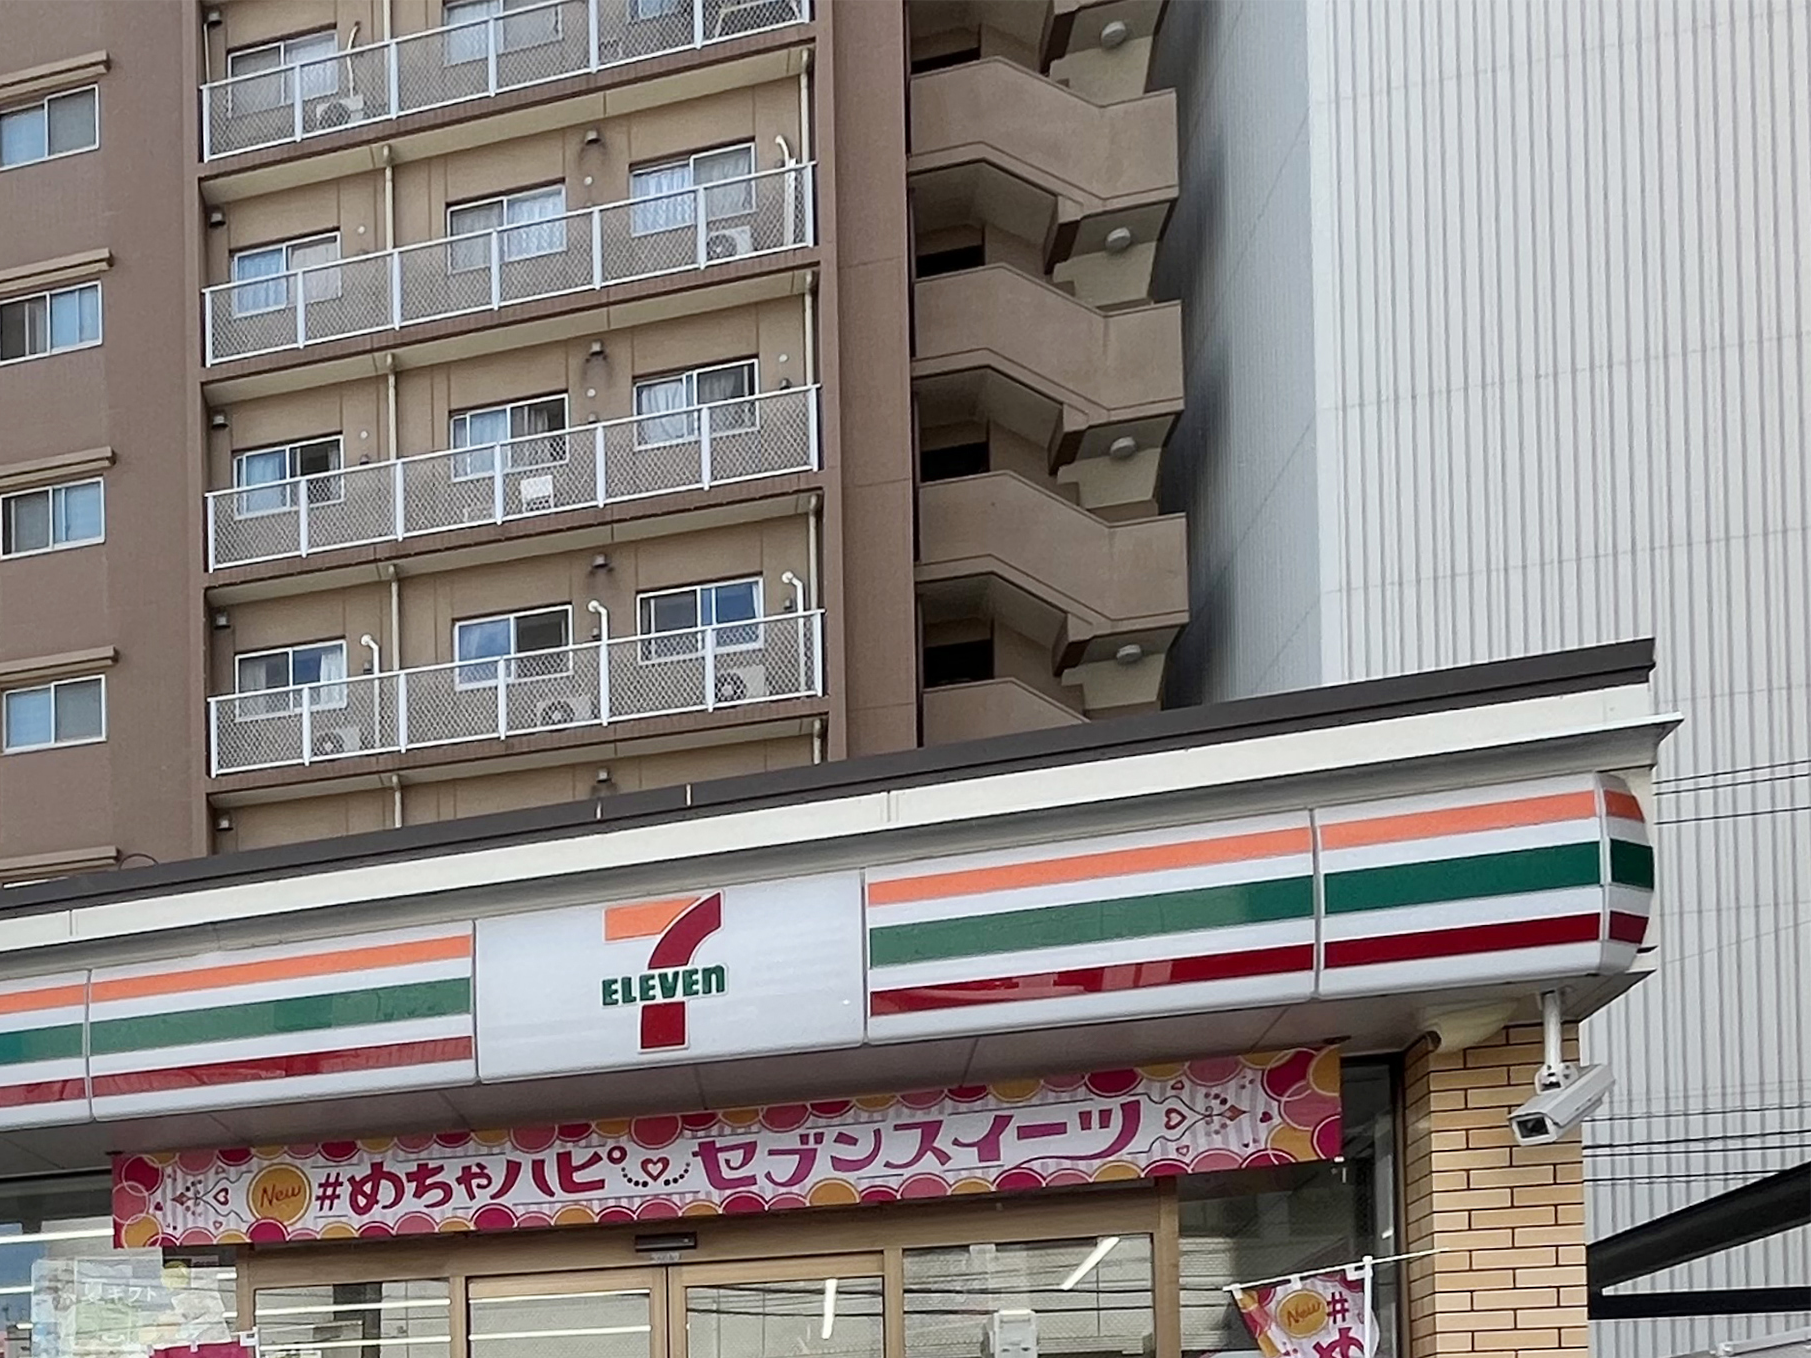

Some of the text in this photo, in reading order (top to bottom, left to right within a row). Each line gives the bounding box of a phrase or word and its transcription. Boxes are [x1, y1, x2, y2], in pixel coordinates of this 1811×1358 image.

[316, 1099, 1144, 1218] #めちゃハピ セブンスイーツ
[259, 1184, 302, 1208] New
[1286, 1301, 1322, 1326] New
